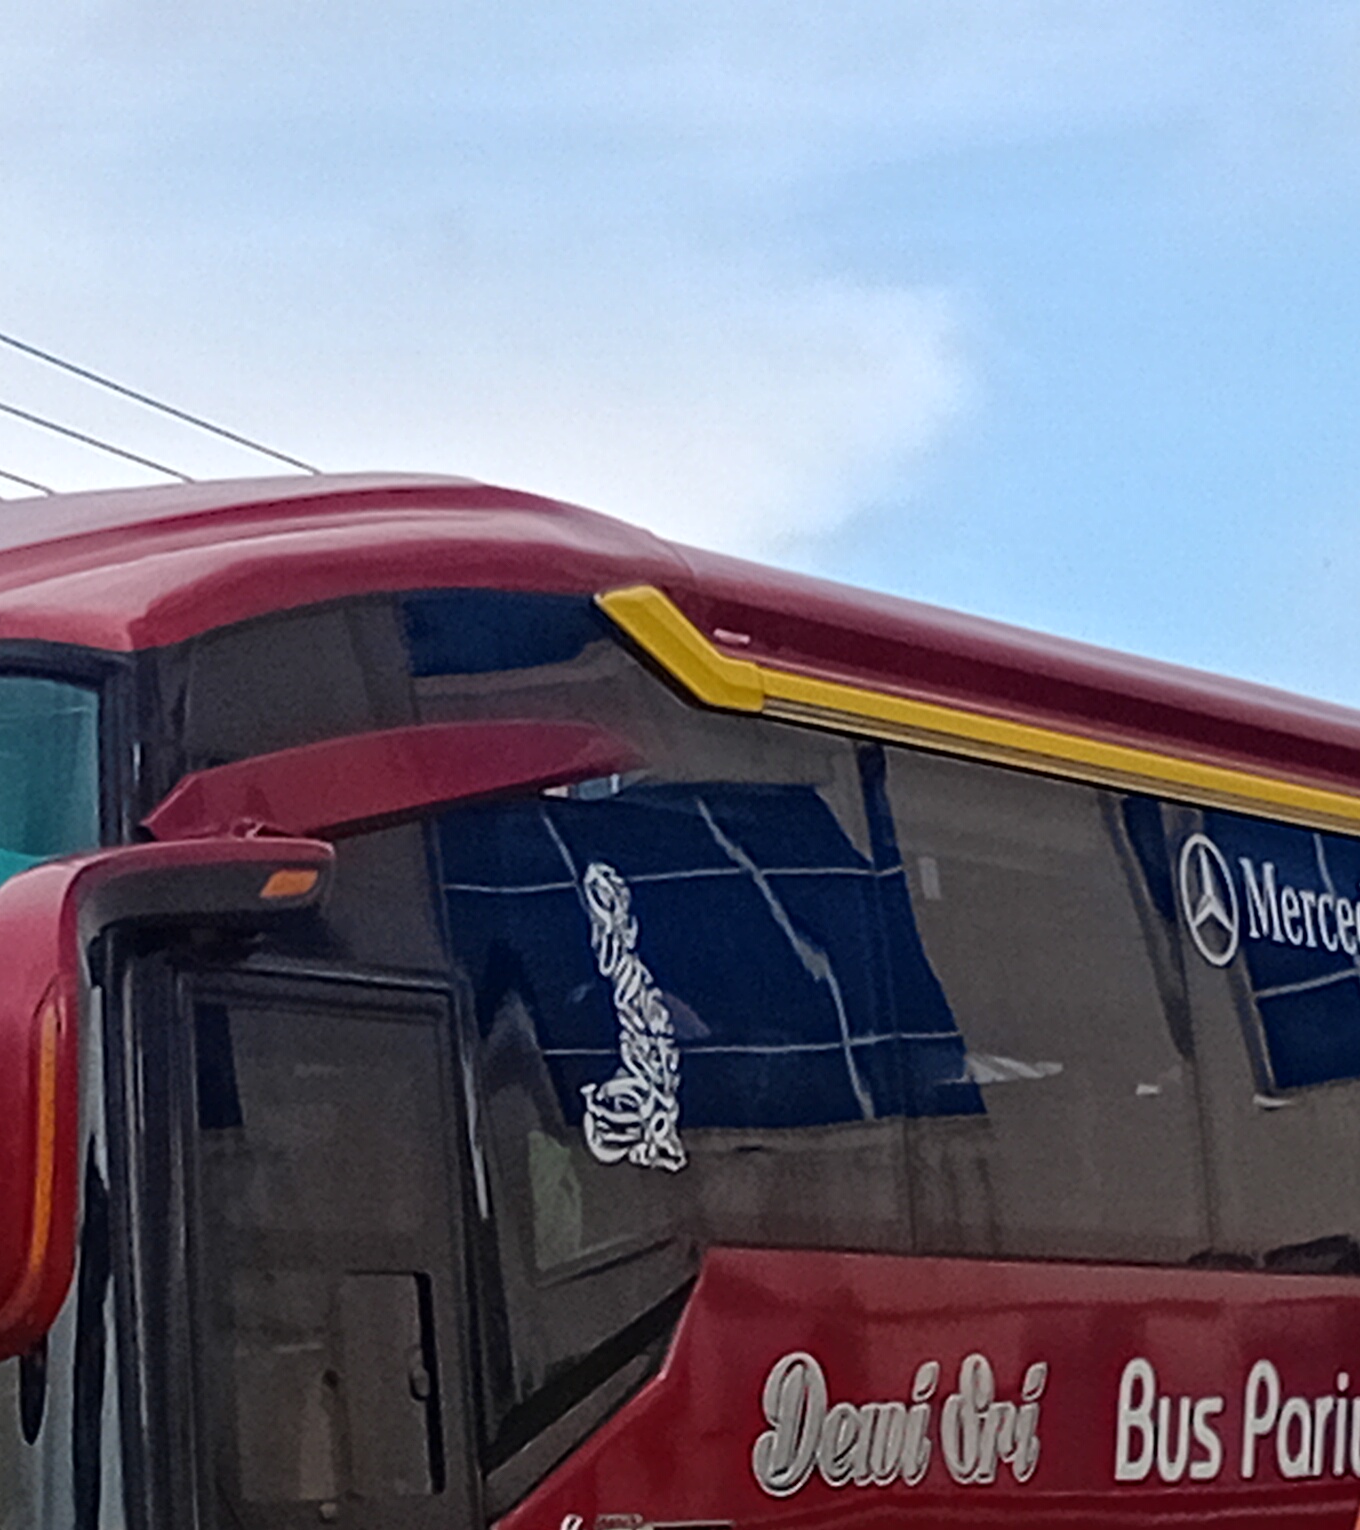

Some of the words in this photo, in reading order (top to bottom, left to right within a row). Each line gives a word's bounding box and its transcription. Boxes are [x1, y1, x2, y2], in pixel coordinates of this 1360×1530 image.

[752, 1351, 939, 1497] Dewi
[940, 1353, 1048, 1484] Sri
[1114, 1356, 1224, 1482] Bus
